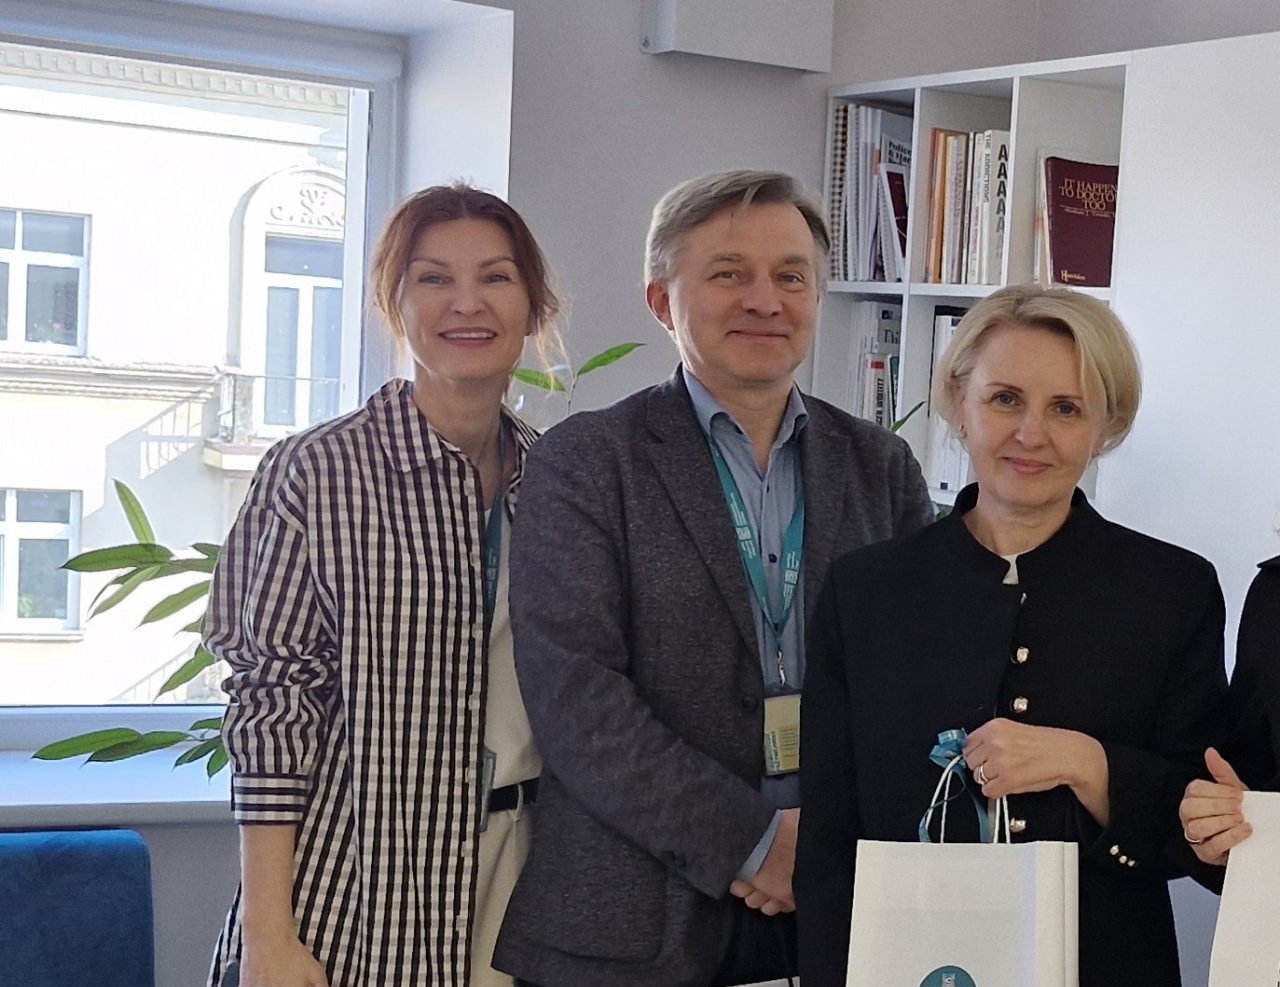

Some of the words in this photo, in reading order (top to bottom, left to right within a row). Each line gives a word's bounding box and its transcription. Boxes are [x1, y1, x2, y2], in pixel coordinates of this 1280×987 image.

[1064, 178, 1075, 188] IT
[1060, 186, 1074, 198] TO
[1082, 200, 1106, 210] TOO
